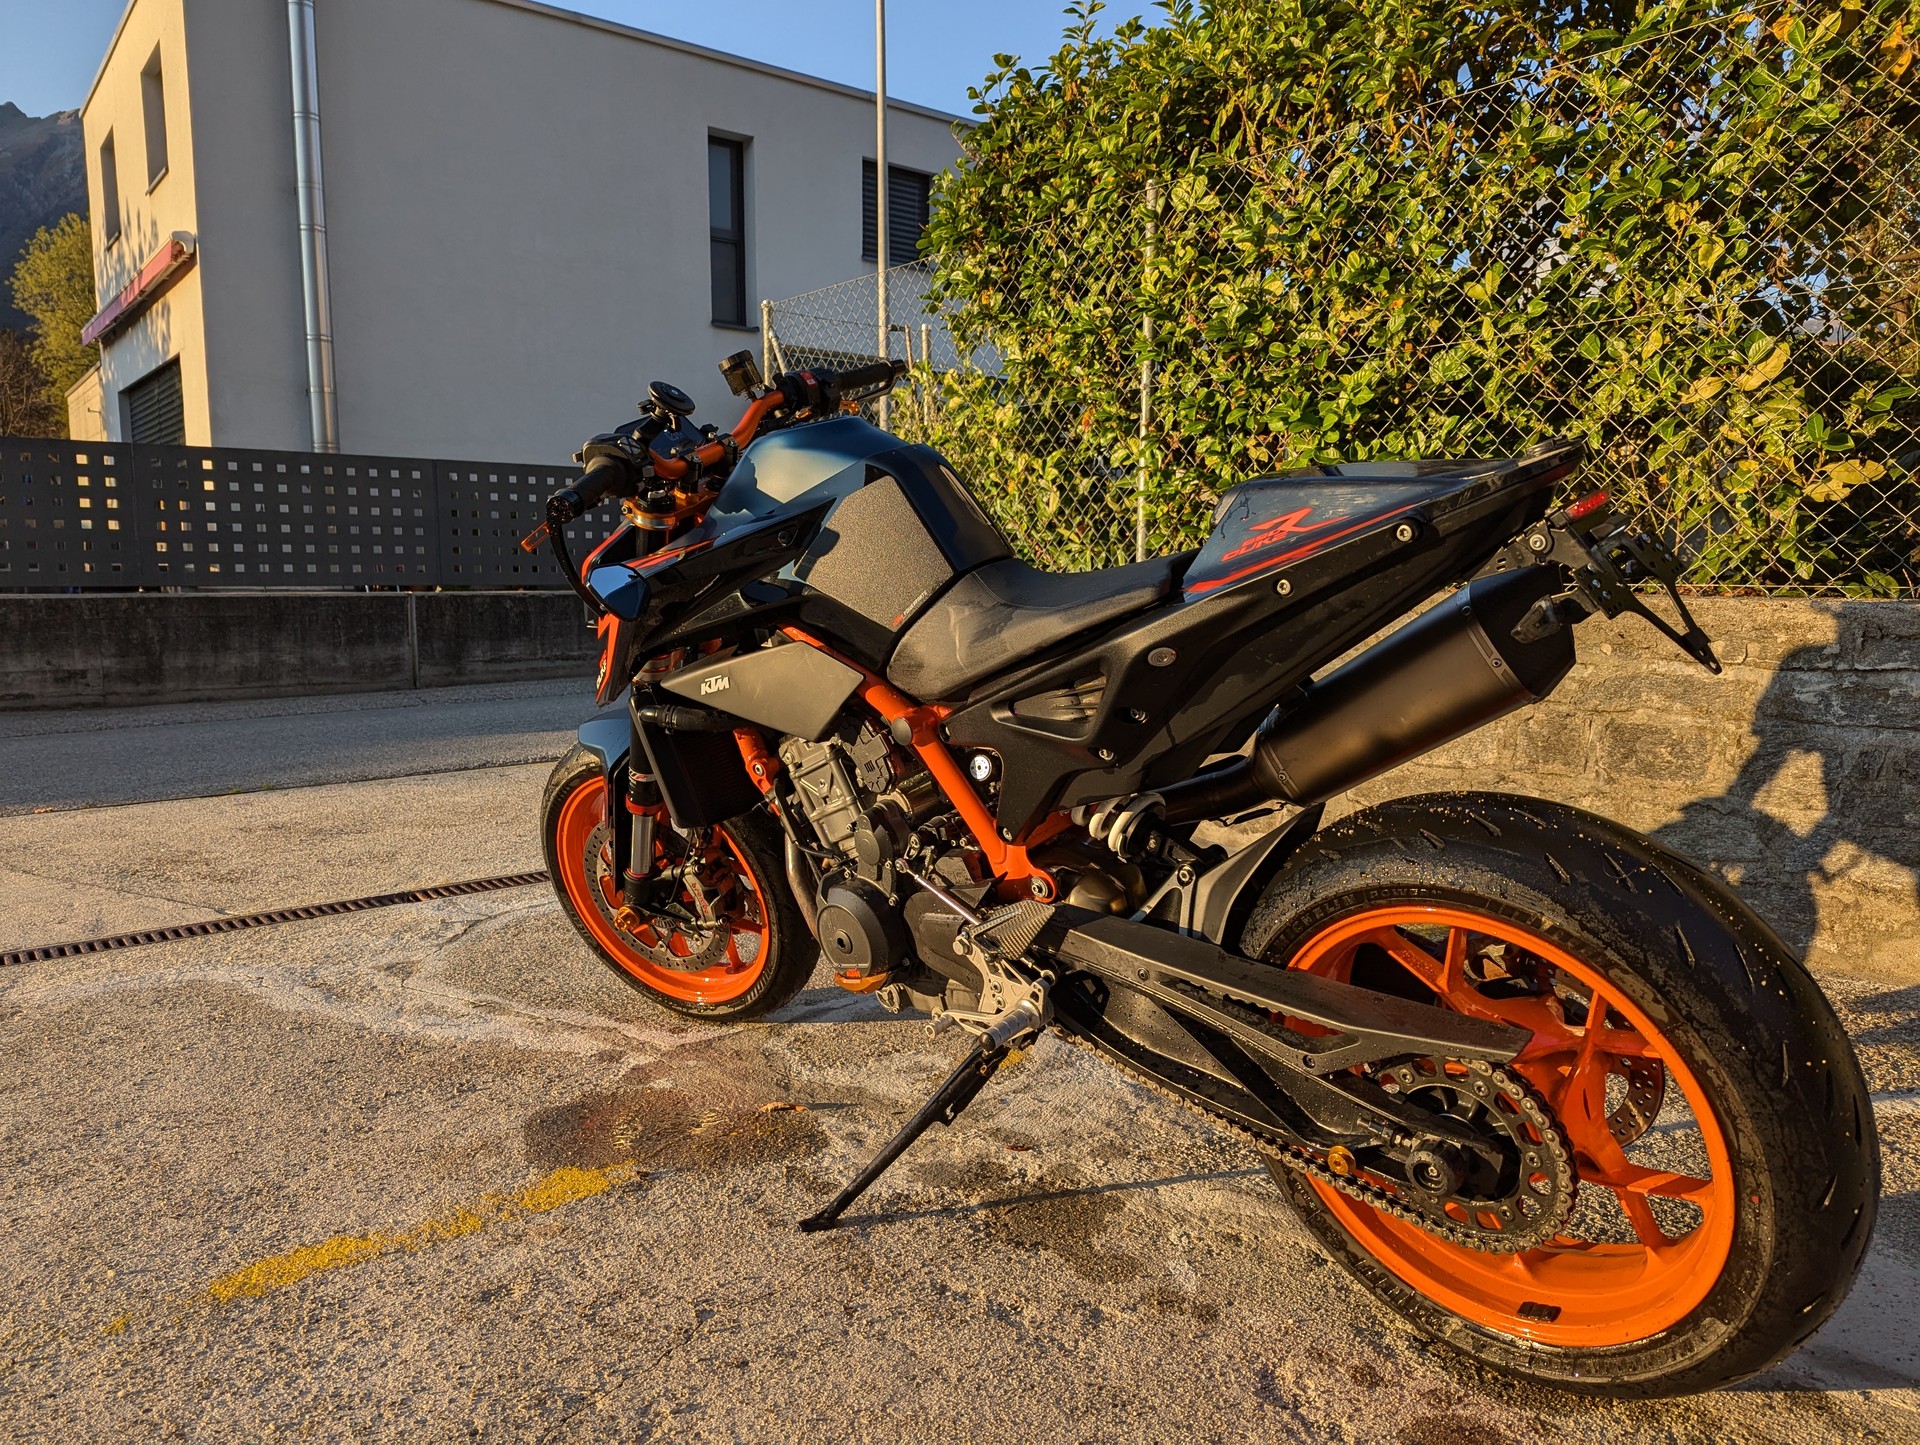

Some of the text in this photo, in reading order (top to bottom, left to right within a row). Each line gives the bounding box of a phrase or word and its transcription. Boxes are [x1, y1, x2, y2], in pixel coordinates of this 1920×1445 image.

[1221, 530, 1287, 562] DUKE
[700, 675, 730, 696] KTM
[1273, 895, 1355, 951] MICHELIN
[1369, 887, 1431, 899] POWER
